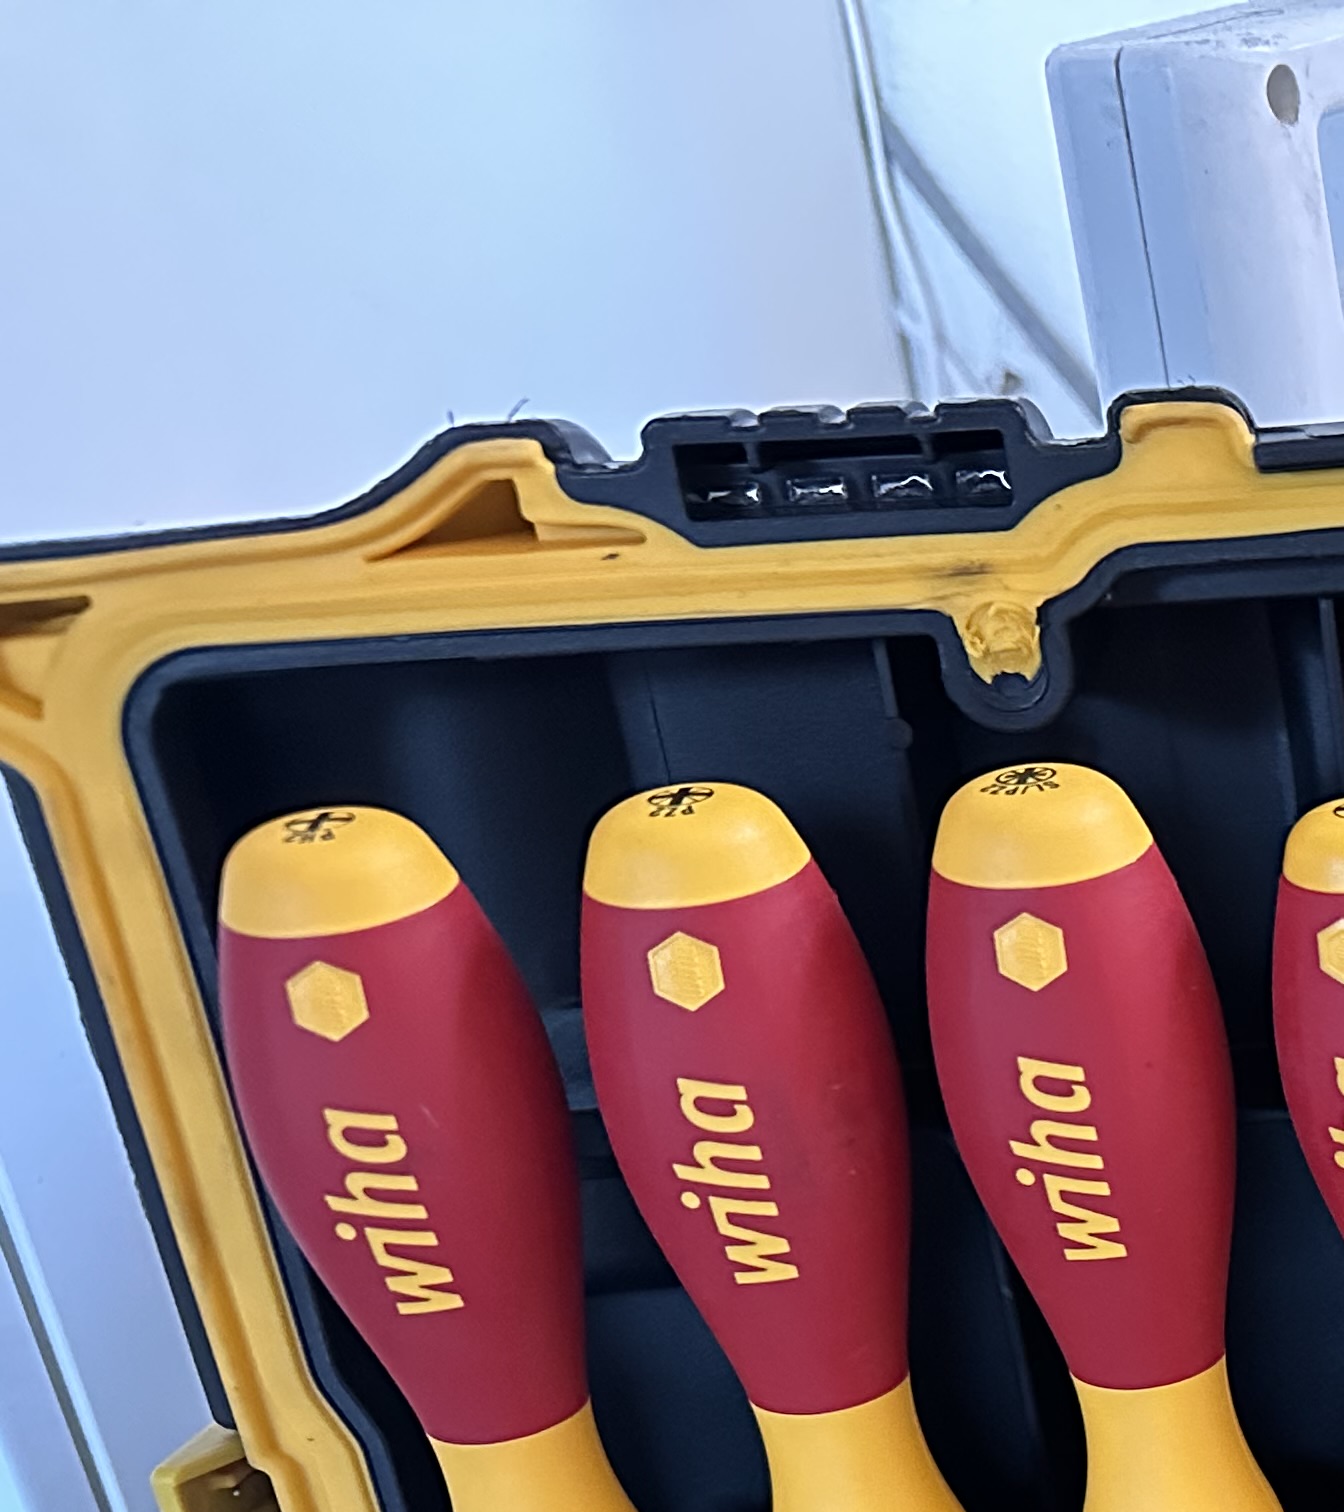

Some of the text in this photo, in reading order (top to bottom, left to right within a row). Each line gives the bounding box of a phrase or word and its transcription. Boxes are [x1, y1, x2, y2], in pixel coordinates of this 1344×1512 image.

[325, 1109, 463, 1314] wiha
[673, 1078, 798, 1284] wiha
[1011, 1057, 1127, 1260] wiha
